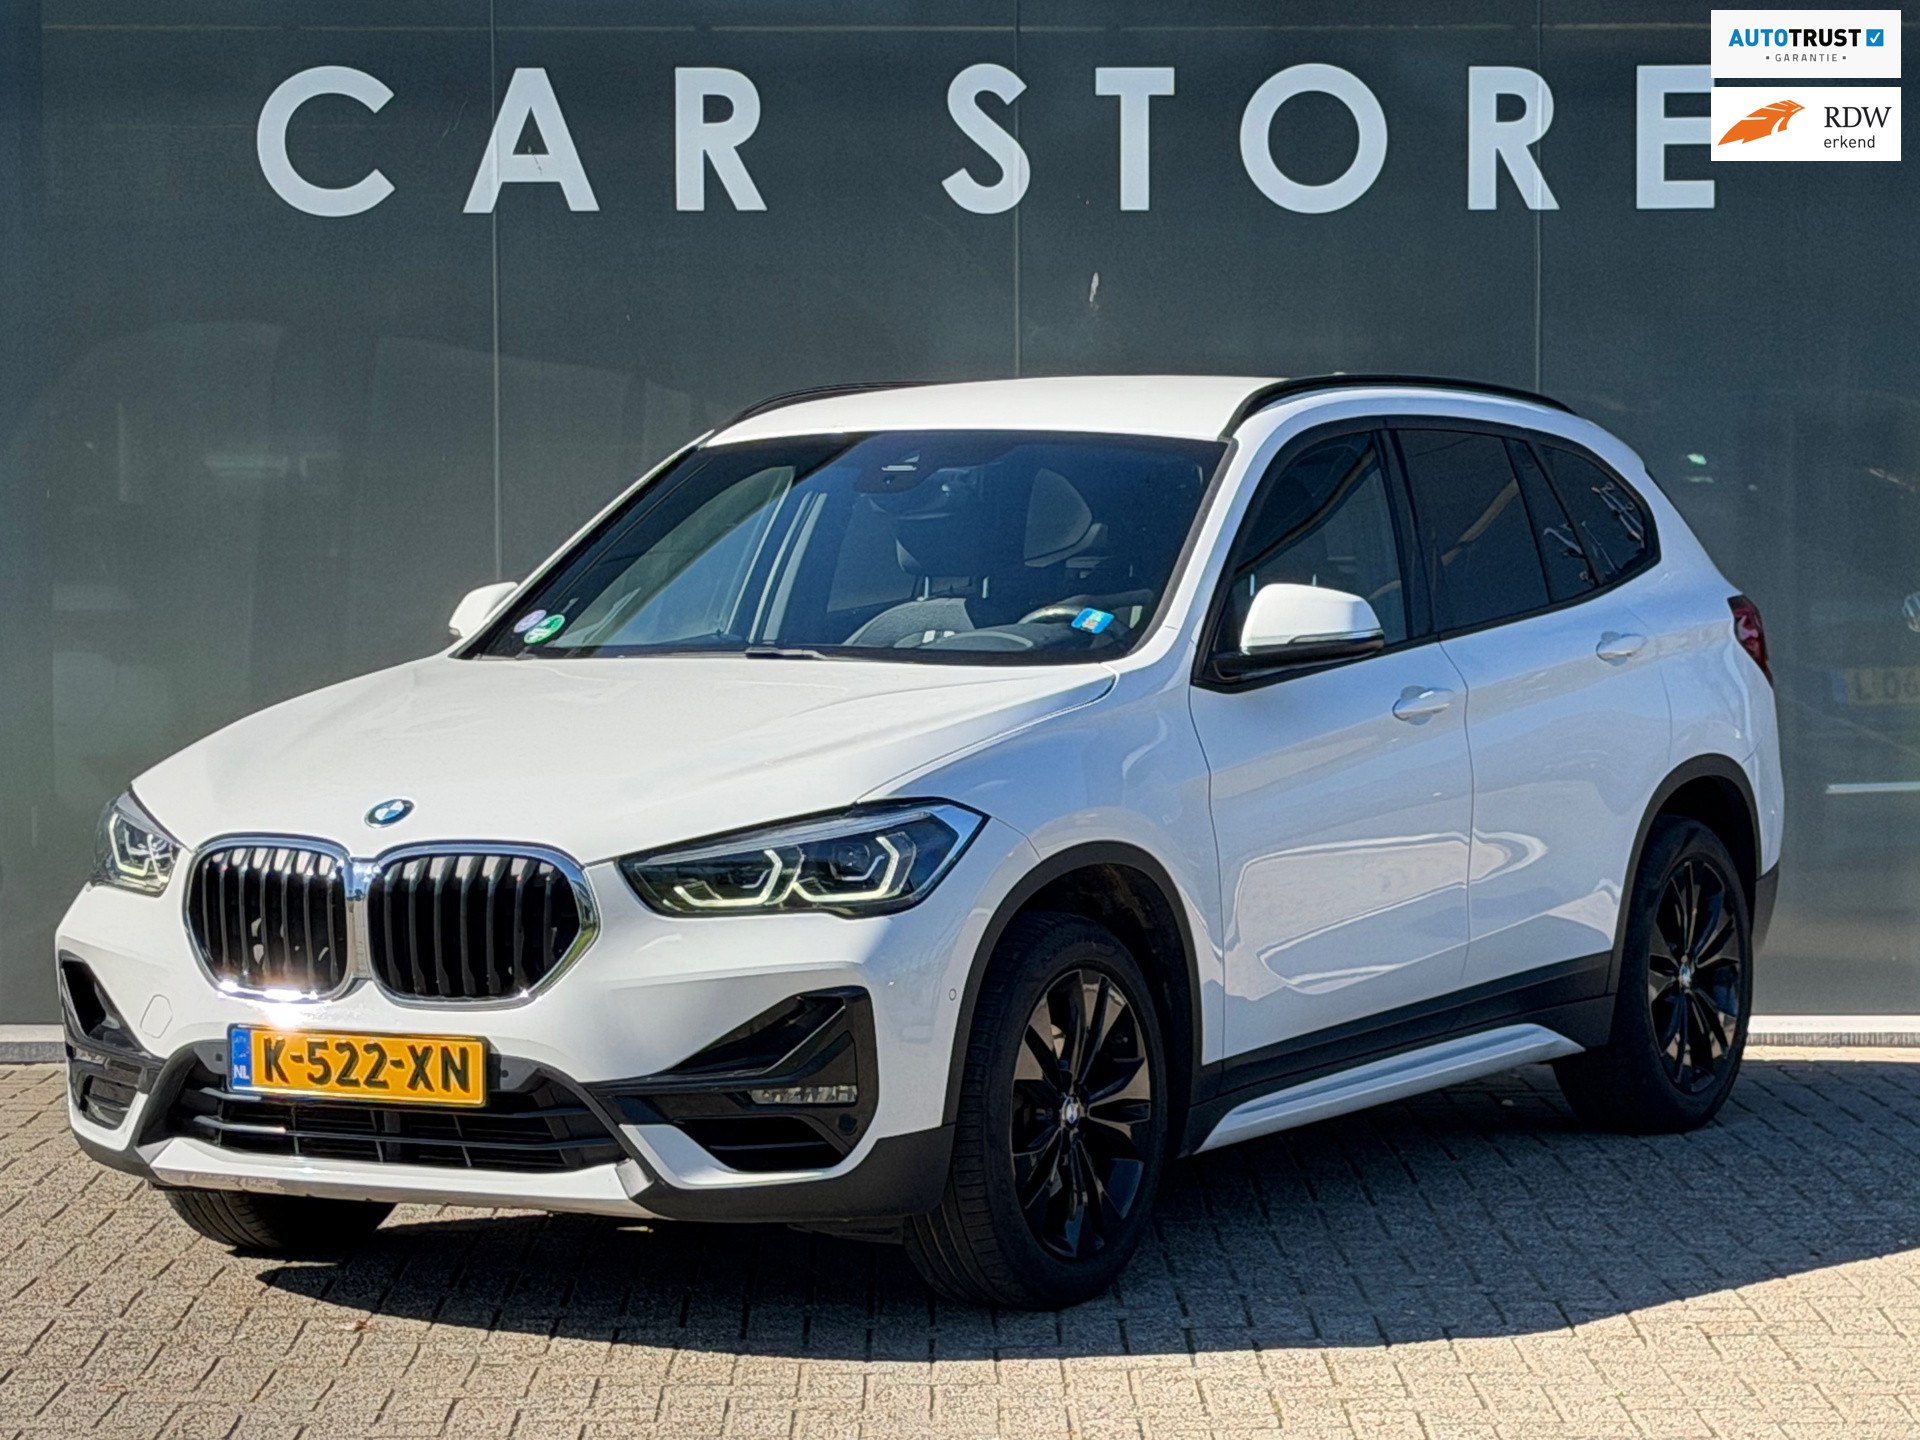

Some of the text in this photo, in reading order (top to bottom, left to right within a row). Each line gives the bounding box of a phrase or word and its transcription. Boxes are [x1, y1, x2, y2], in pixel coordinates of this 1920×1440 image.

[256, 63, 1716, 217] CAR STORE
[233, 1036, 471, 1094] NL K-522-XN
